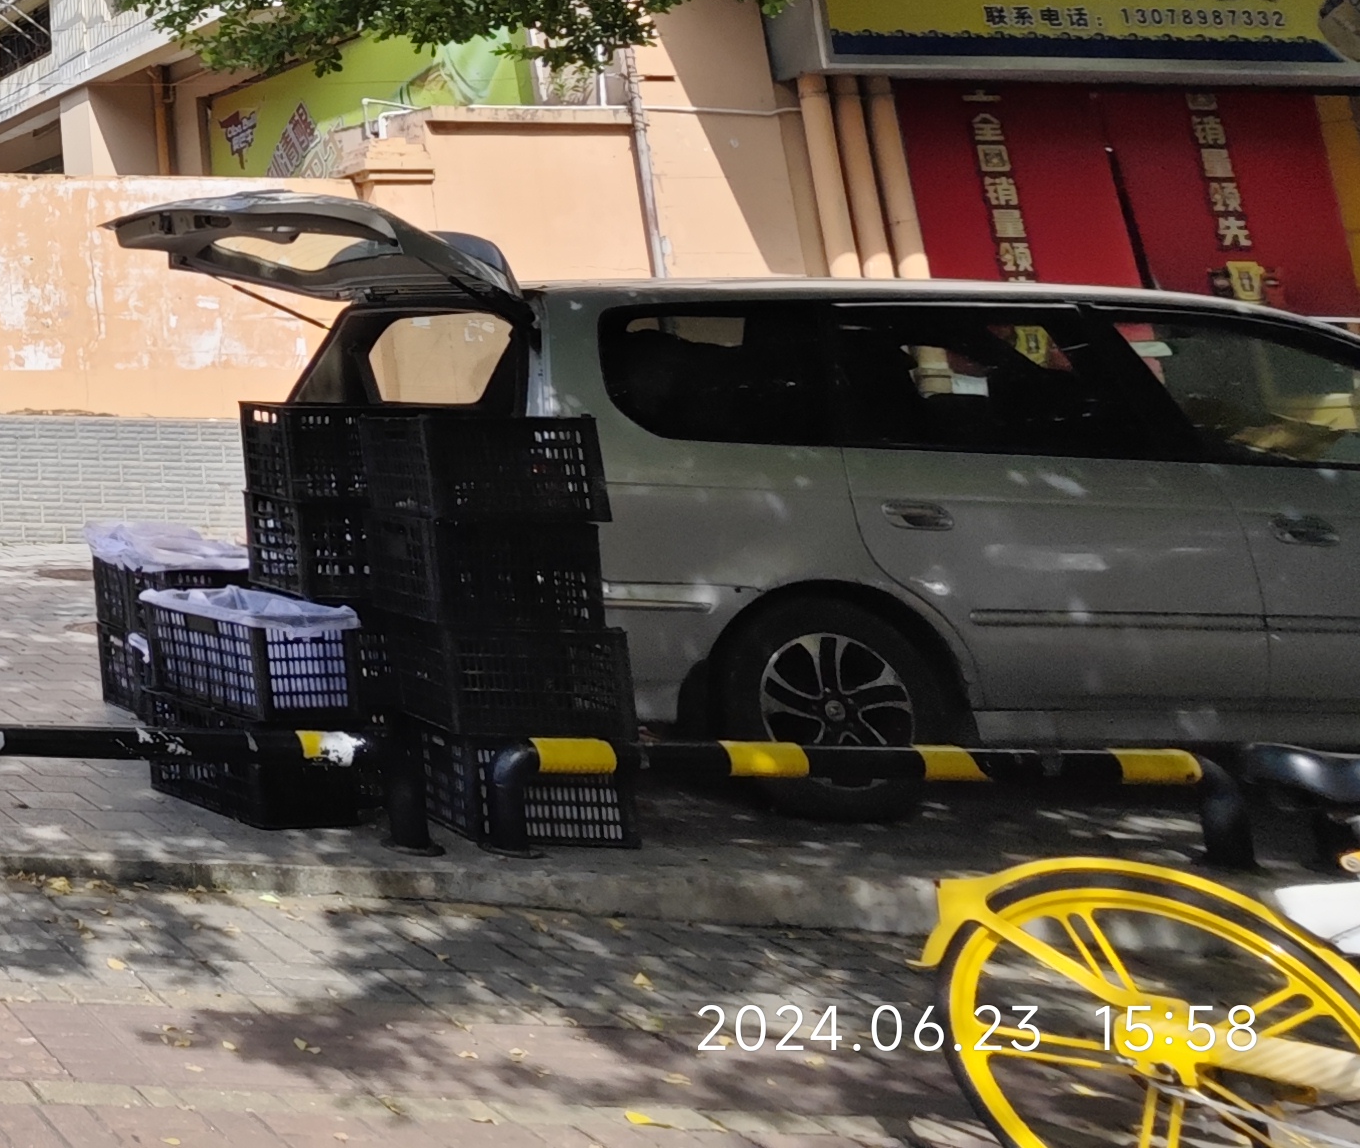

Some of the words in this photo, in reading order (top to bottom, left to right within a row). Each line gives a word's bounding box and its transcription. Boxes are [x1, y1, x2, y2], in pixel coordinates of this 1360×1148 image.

[1120, 8, 1286, 28] 13078987332
[971, 113, 1037, 282] 全国销量领
